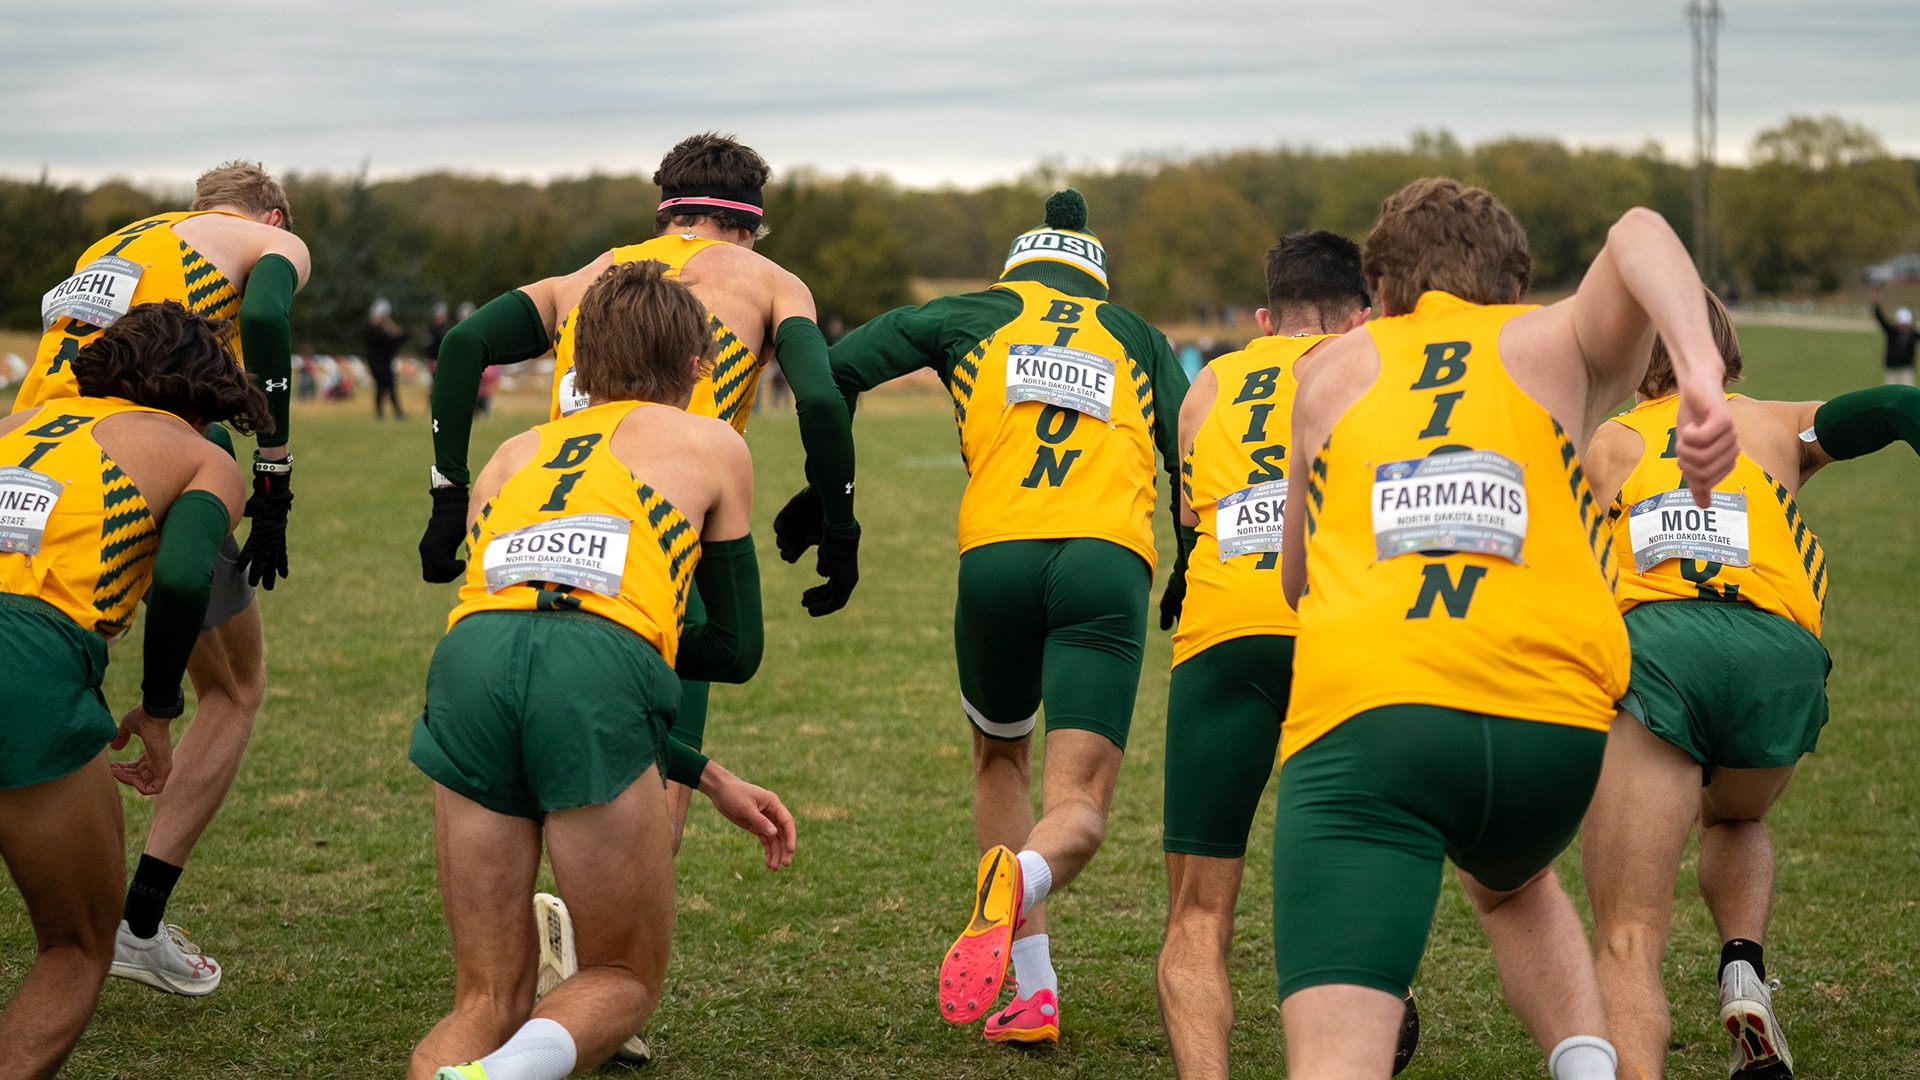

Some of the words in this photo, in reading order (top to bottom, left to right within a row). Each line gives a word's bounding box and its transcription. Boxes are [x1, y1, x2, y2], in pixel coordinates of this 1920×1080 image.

[1013, 234, 1103, 266] NDSU
[53, 273, 116, 299] ROEHL
[66, 293, 90, 302] DAKOTA
[91, 296, 112, 307] STATE
[1063, 348, 1085, 356] SUMMIT
[1085, 353, 1103, 362] LEAGUE
[1016, 358, 1107, 394] KNODLE
[1020, 299, 1085, 488] BION
[1023, 377, 1046, 386] NORTH
[1048, 380, 1075, 392] DAKOTA
[1077, 388, 1097, 399] STATE
[574, 398, 590, 408] NOR
[24, 472, 49, 482] LEAGUE
[1381, 480, 1522, 514] FARMAKIS
[1711, 494, 1731, 502] LEAGUE
[0, 516, 26, 526] STATE
[588, 516, 613, 524] LEAGUE
[1398, 514, 1431, 526] NORTH
[1434, 512, 1473, 522] DAKOTA
[1477, 514, 1505, 526] STATE
[1662, 510, 1717, 532] MOE
[1238, 526, 1264, 535] NORTH
[1266, 524, 1283, 532] DAK
[506, 532, 608, 559] BOSCH
[1649, 534, 1674, 544] NORTH
[1677, 533, 1706, 541] DAKOTA
[1708, 535, 1731, 545] STATE
[1654, 545, 1680, 554] UNIVERSITY
[1688, 545, 1713, 553] NEBRASKA
[505, 555, 535, 563] NORTH
[538, 555, 572, 564] DAKOTA
[575, 558, 602, 569] STATE
